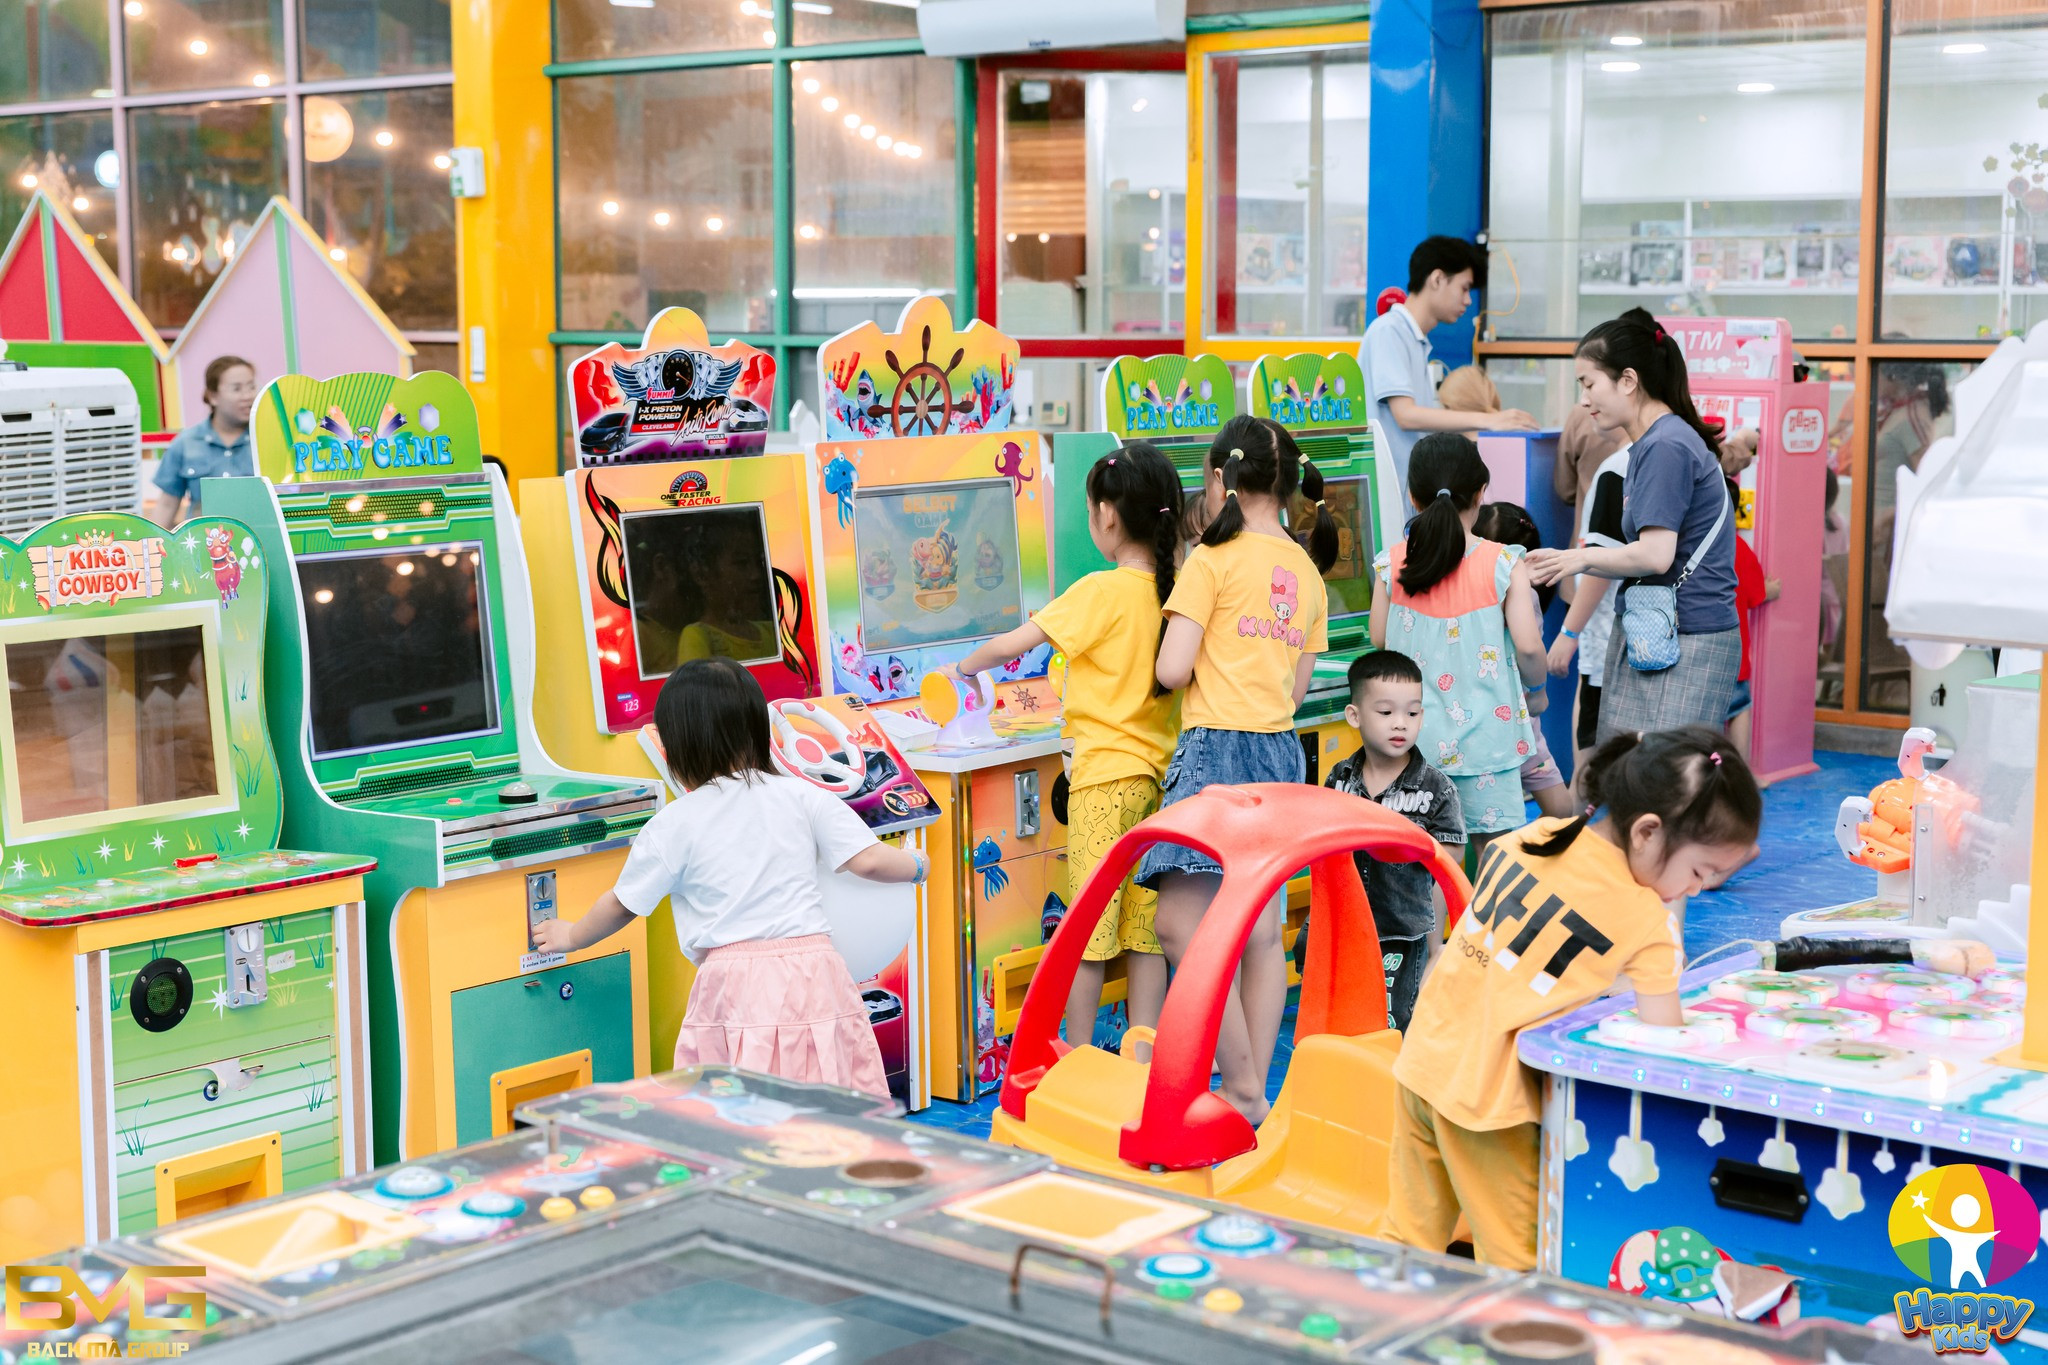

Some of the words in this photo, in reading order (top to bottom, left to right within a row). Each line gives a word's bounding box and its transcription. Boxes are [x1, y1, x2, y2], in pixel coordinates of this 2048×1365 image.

[651, 405, 683, 413] PISTON
[1126, 405, 1168, 431] PLAY
[1171, 403, 1220, 429] GAME
[1270, 400, 1309, 424] PLAY
[1310, 399, 1352, 423] GAME
[638, 413, 682, 422] POWERED
[641, 423, 676, 431] CLEVELAND
[292, 439, 364, 473] PLAY
[372, 435, 454, 470] GAME
[677, 496, 721, 507] RACING
[679, 490, 711, 499] FASTER
[903, 495, 957, 513] SELECT
[68, 546, 126, 570] KING
[58, 570, 140, 597] COWBOY
[624, 698, 639, 712] 123
